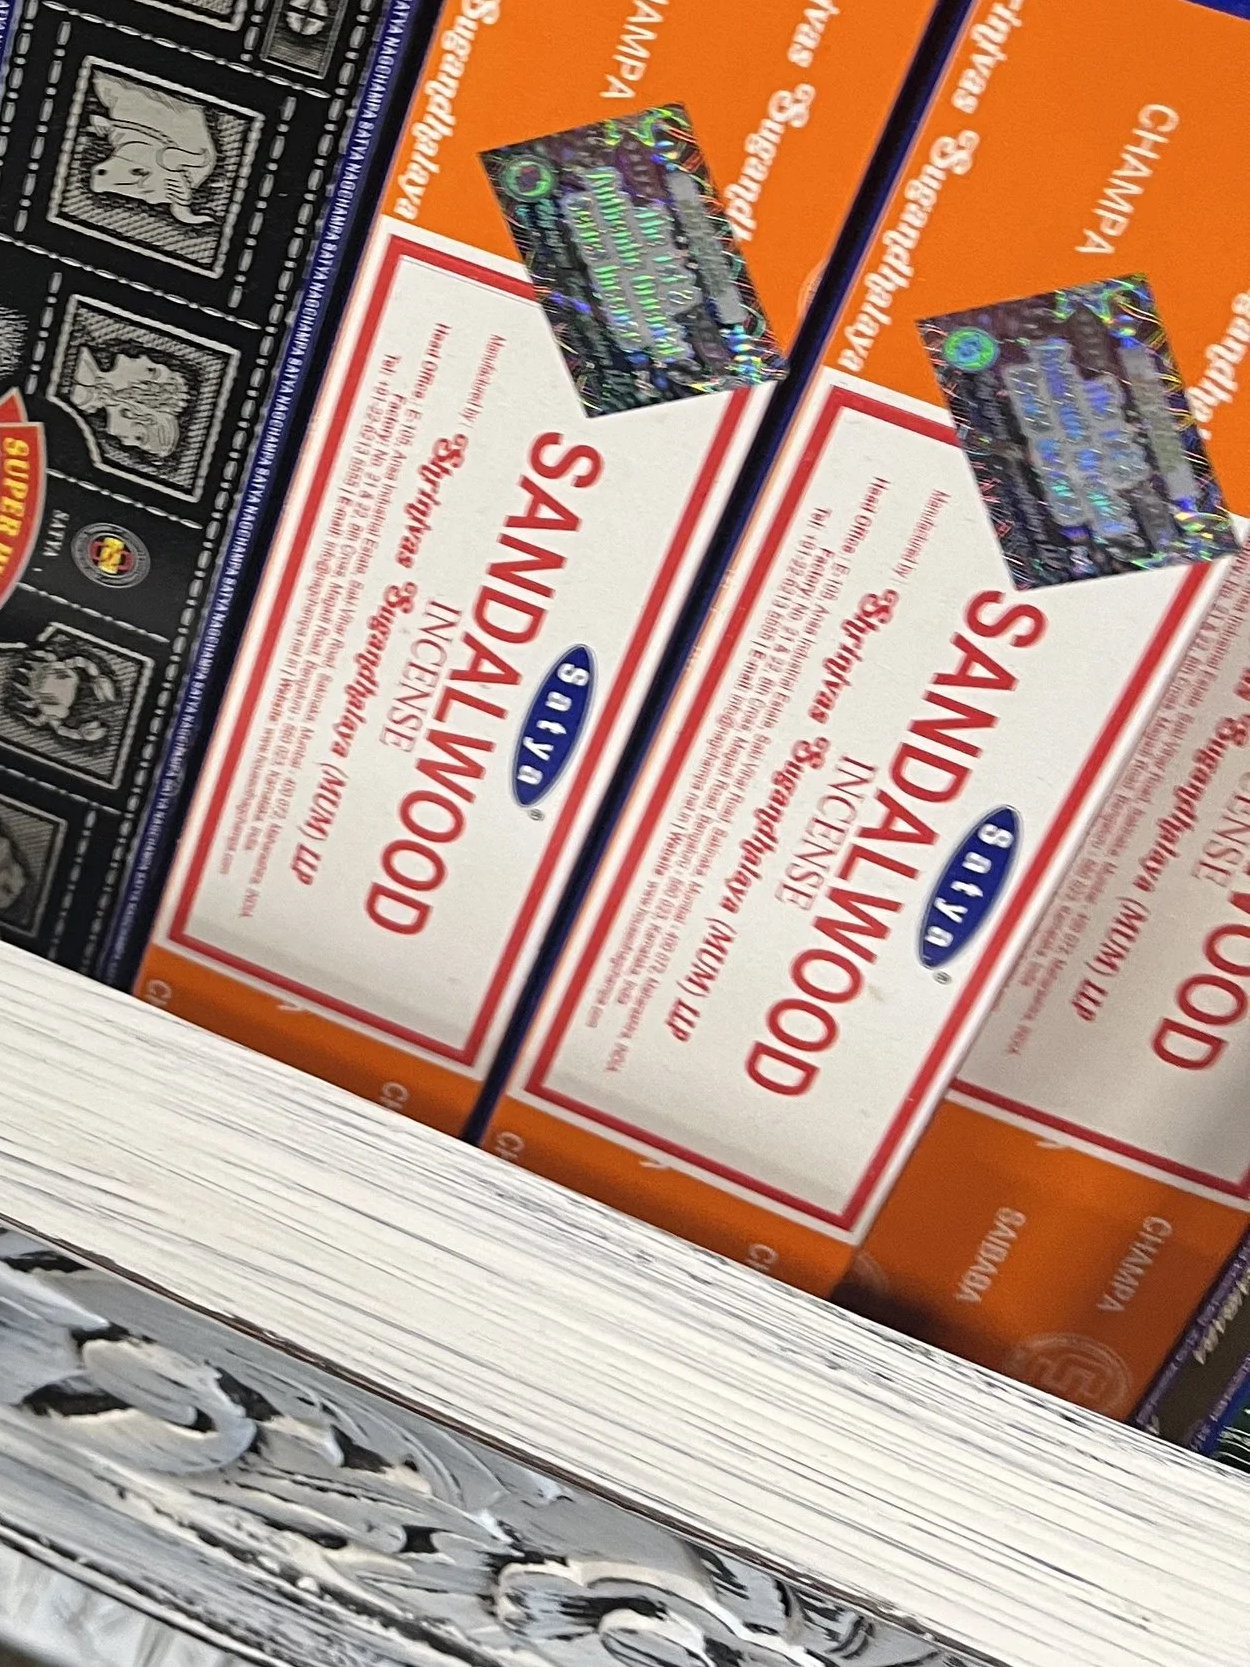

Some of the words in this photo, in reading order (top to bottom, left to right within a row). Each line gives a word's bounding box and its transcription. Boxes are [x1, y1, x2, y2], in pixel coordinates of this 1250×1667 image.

[1074, 101, 1182, 256] CHAMPA
[837, 129, 982, 374] Sugandhalaya
[427, 322, 448, 359] Head
[395, 432, 467, 568] Shrinivas
[860, 477, 886, 513] Head
[330, 580, 416, 758] Sugandhalaya
[364, 430, 603, 936] SANDALWOOD
[381, 597, 462, 744] INCENSE
[808, 589, 897, 723] Shrinivas
[516, 661, 591, 786] Satya
[305, 762, 346, 837] (MUM)
[719, 735, 829, 914] Sugandhalaya
[744, 589, 1047, 1097] SANDALWOOD
[779, 753, 876, 910] INCENSE
[290, 843, 320, 886] LLP
[922, 822, 1015, 948] Satya
[685, 918, 734, 993] (MUM)
[1071, 978, 1107, 1021] LLP
[1093, 904, 1146, 973] (MUM)
[665, 997, 699, 1043] LLP
[1096, 1214, 1175, 1315] CHAMPA
